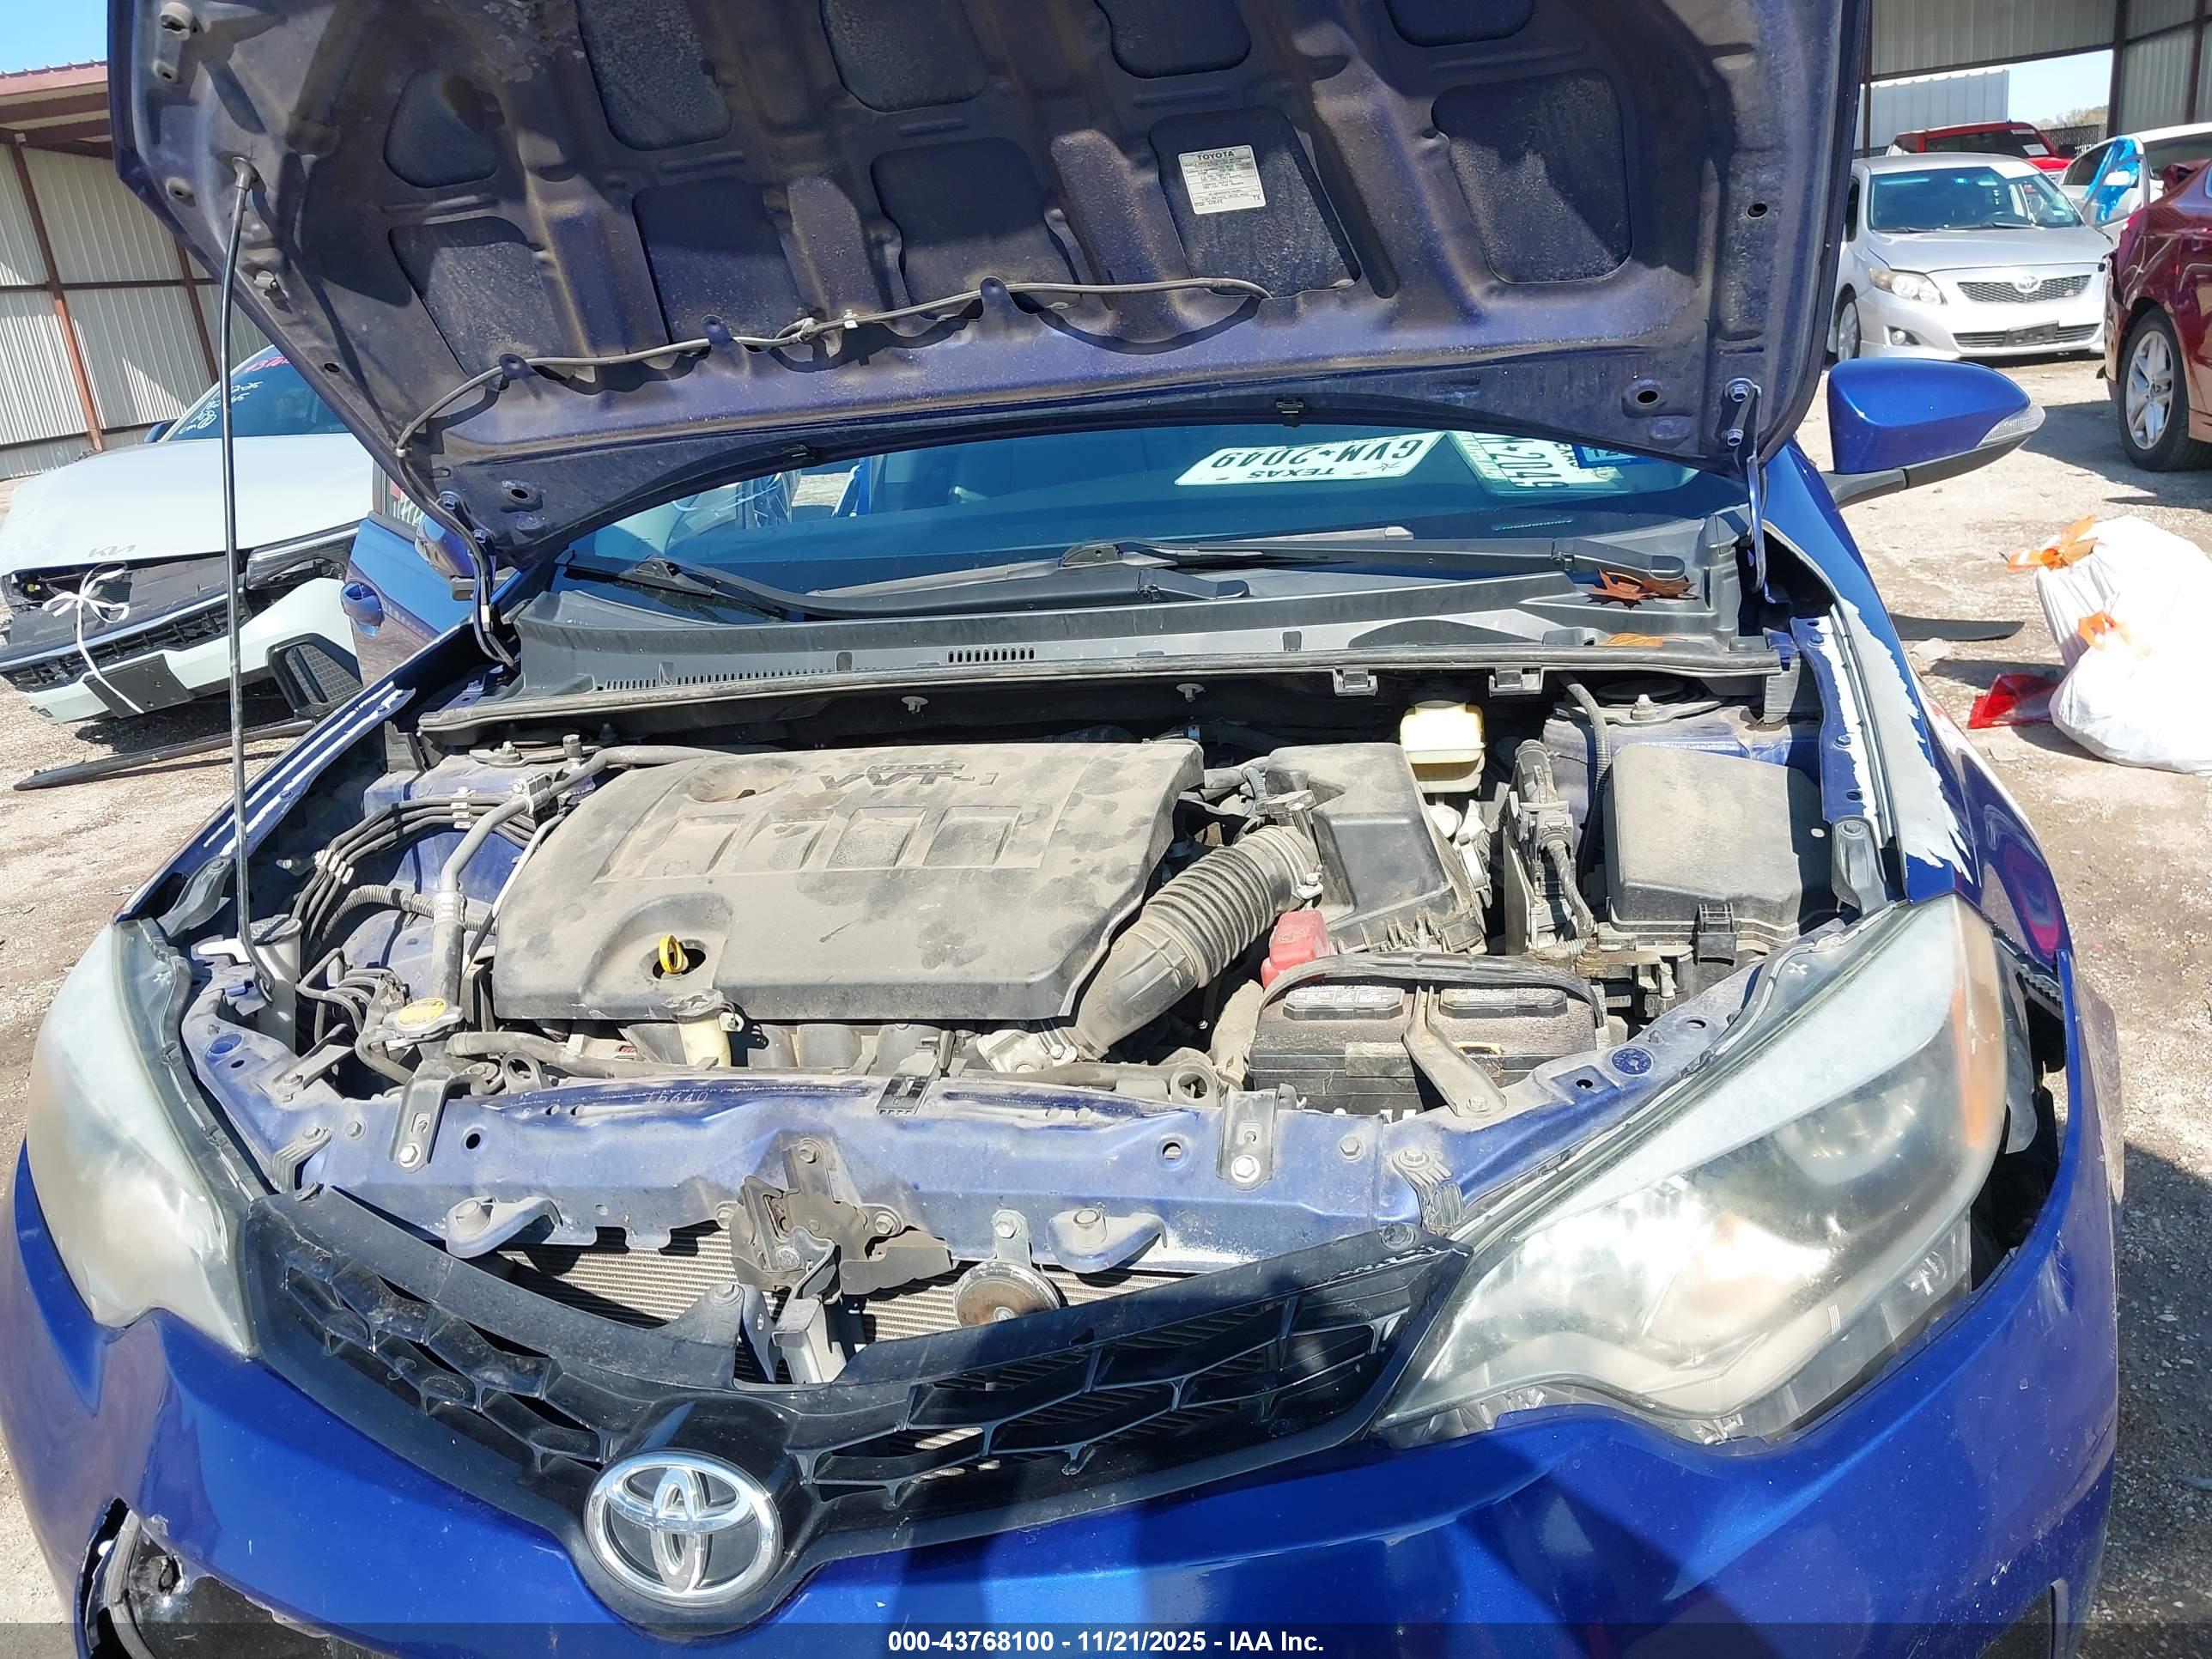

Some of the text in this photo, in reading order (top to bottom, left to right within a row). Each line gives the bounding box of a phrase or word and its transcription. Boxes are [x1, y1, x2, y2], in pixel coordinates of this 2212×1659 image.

[1197, 151, 1235, 161] TOYOTA
[1212, 439, 1422, 469] GVM 2049
[1247, 465, 1336, 481] TEXAS
